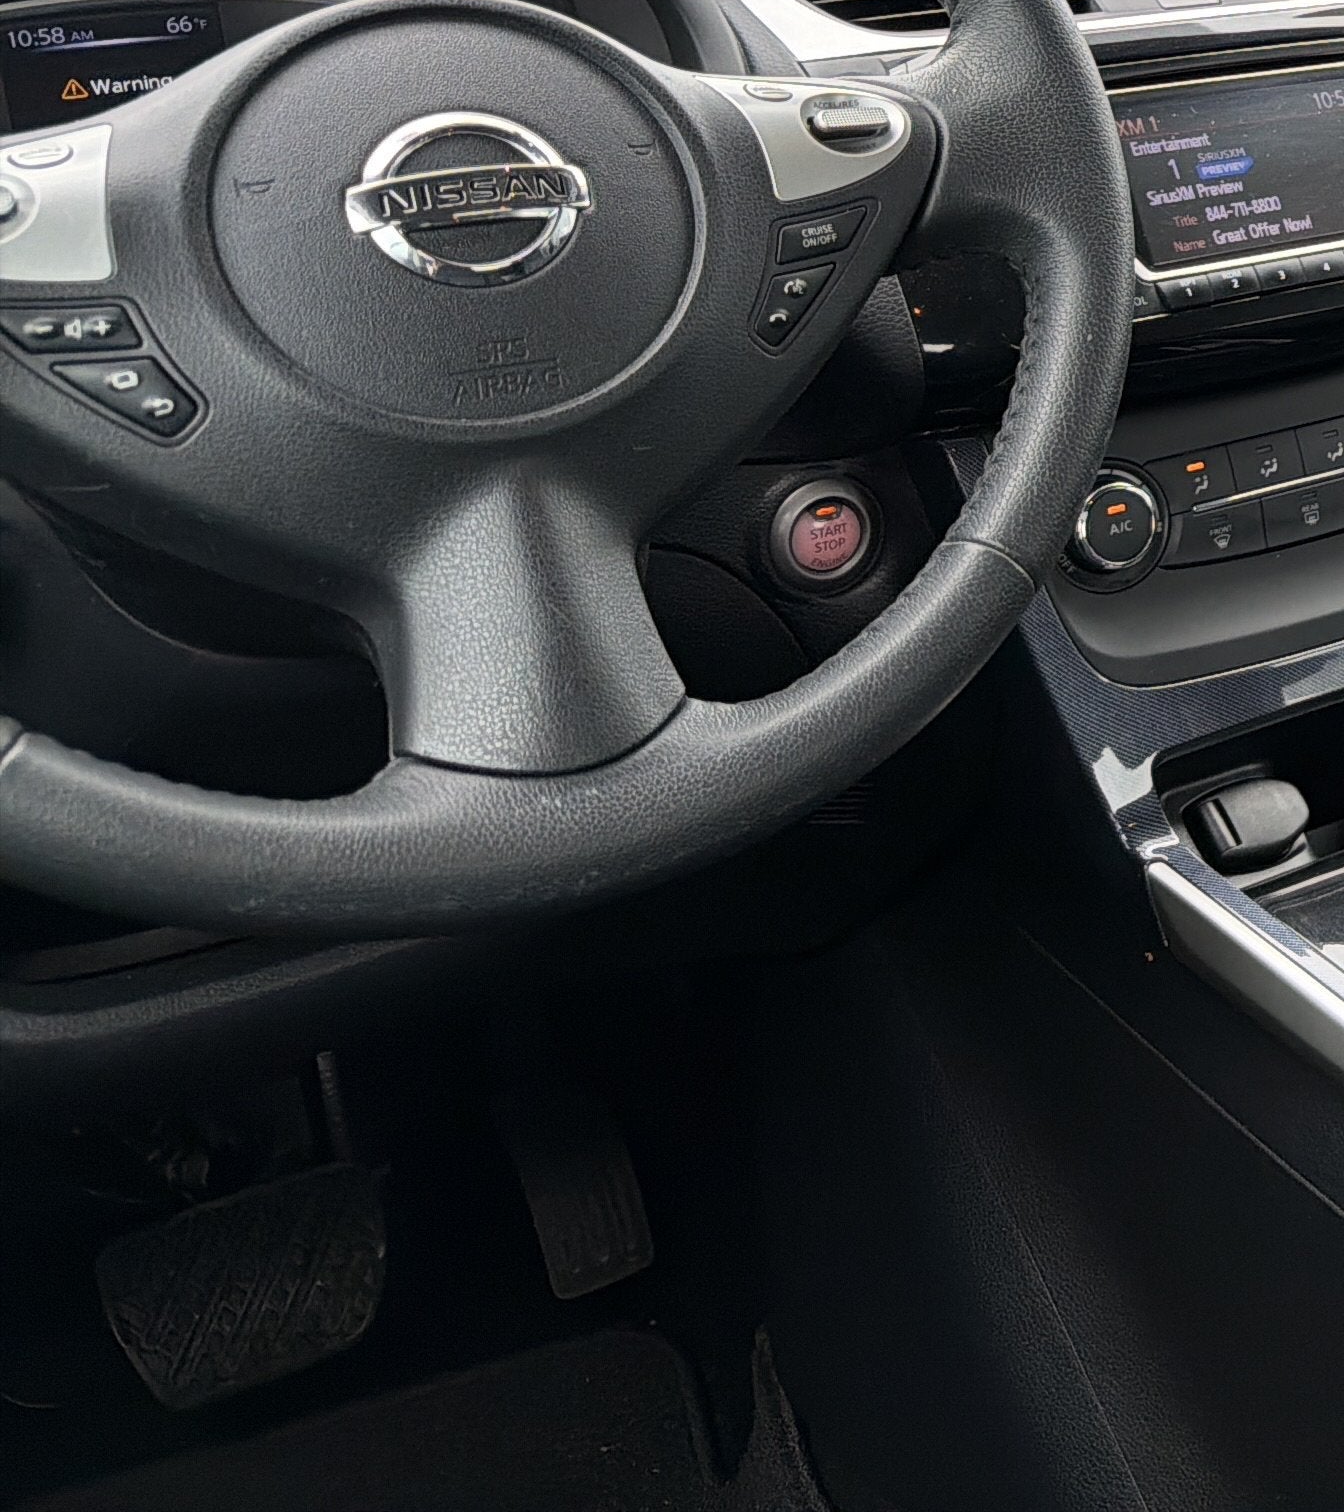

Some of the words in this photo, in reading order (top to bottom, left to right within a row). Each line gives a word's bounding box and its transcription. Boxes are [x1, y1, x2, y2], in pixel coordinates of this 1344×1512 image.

[166, 16, 208, 34] 66°F
[8, 26, 66, 49] 10:58
[71, 30, 94, 41] AM
[1149, 116, 1159, 132] 1
[1129, 133, 1211, 157] Entertainment
[1168, 158, 1180, 180] 1
[379, 173, 569, 218] NISSAN
[1146, 185, 1196, 207] SiriusXM
[1196, 180, 1243, 199] Preview
[1172, 214, 1199, 228] Title
[1205, 196, 1282, 222] 844-711-8800
[802, 224, 834, 238] CRUISE
[1173, 238, 1207, 253] Name
[1212, 226, 1249, 245] Great
[1249, 220, 1281, 239] Offer
[1283, 214, 1314, 234] Now!
[802, 233, 838, 248] ON/OFF
[810, 522, 847, 540] START
[1109, 519, 1133, 536] A/C
[814, 537, 846, 553] STOP
[810, 551, 851, 568] ENGINE
